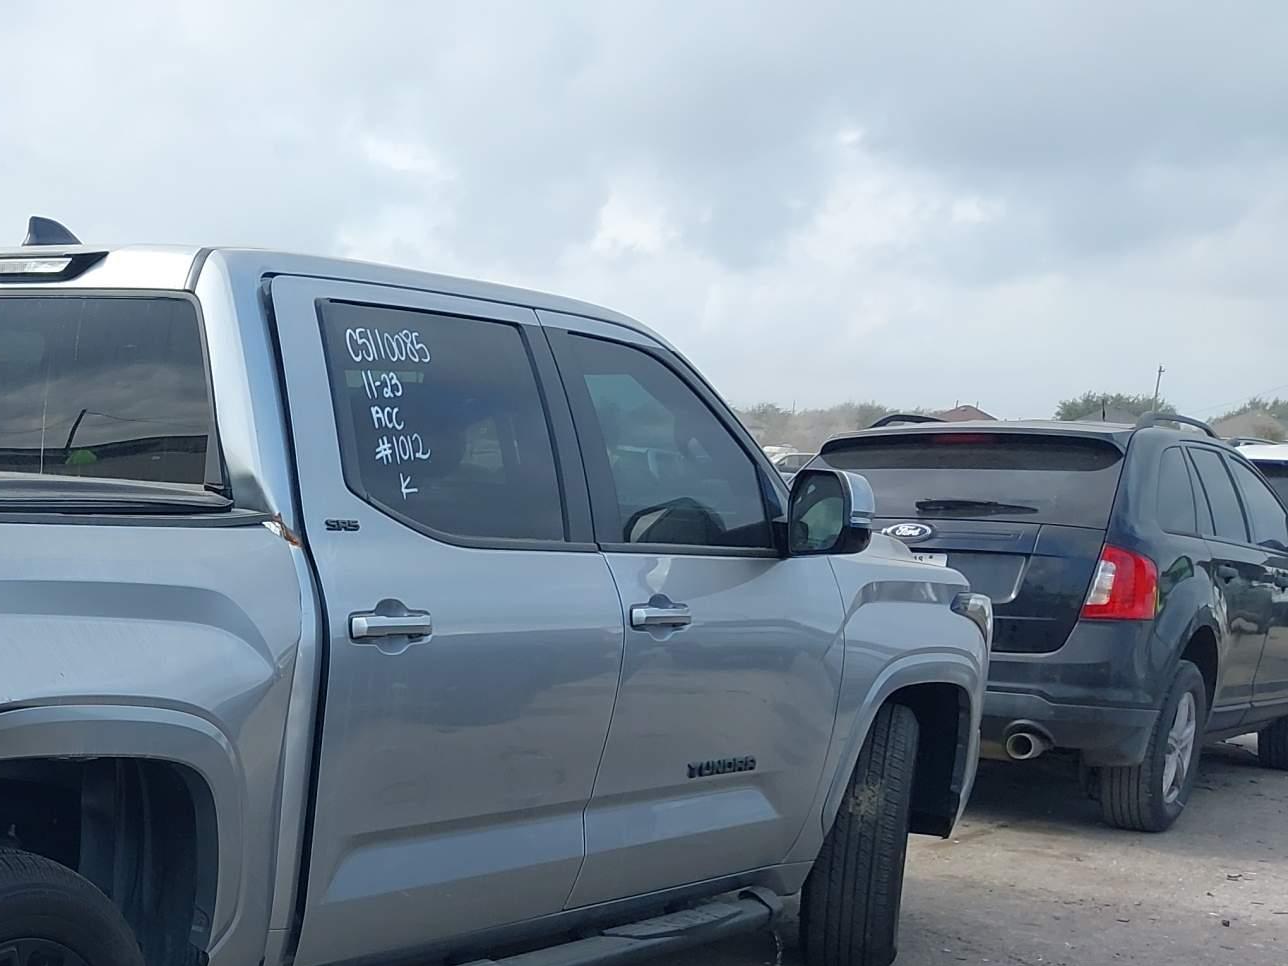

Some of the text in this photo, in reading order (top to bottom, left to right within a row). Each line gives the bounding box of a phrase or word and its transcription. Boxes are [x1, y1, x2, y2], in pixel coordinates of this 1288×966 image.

[361, 368, 403, 399] 11-23
[370, 405, 405, 431] ACC
[375, 432, 431, 465] #1012
[399, 472, 419, 500] K
